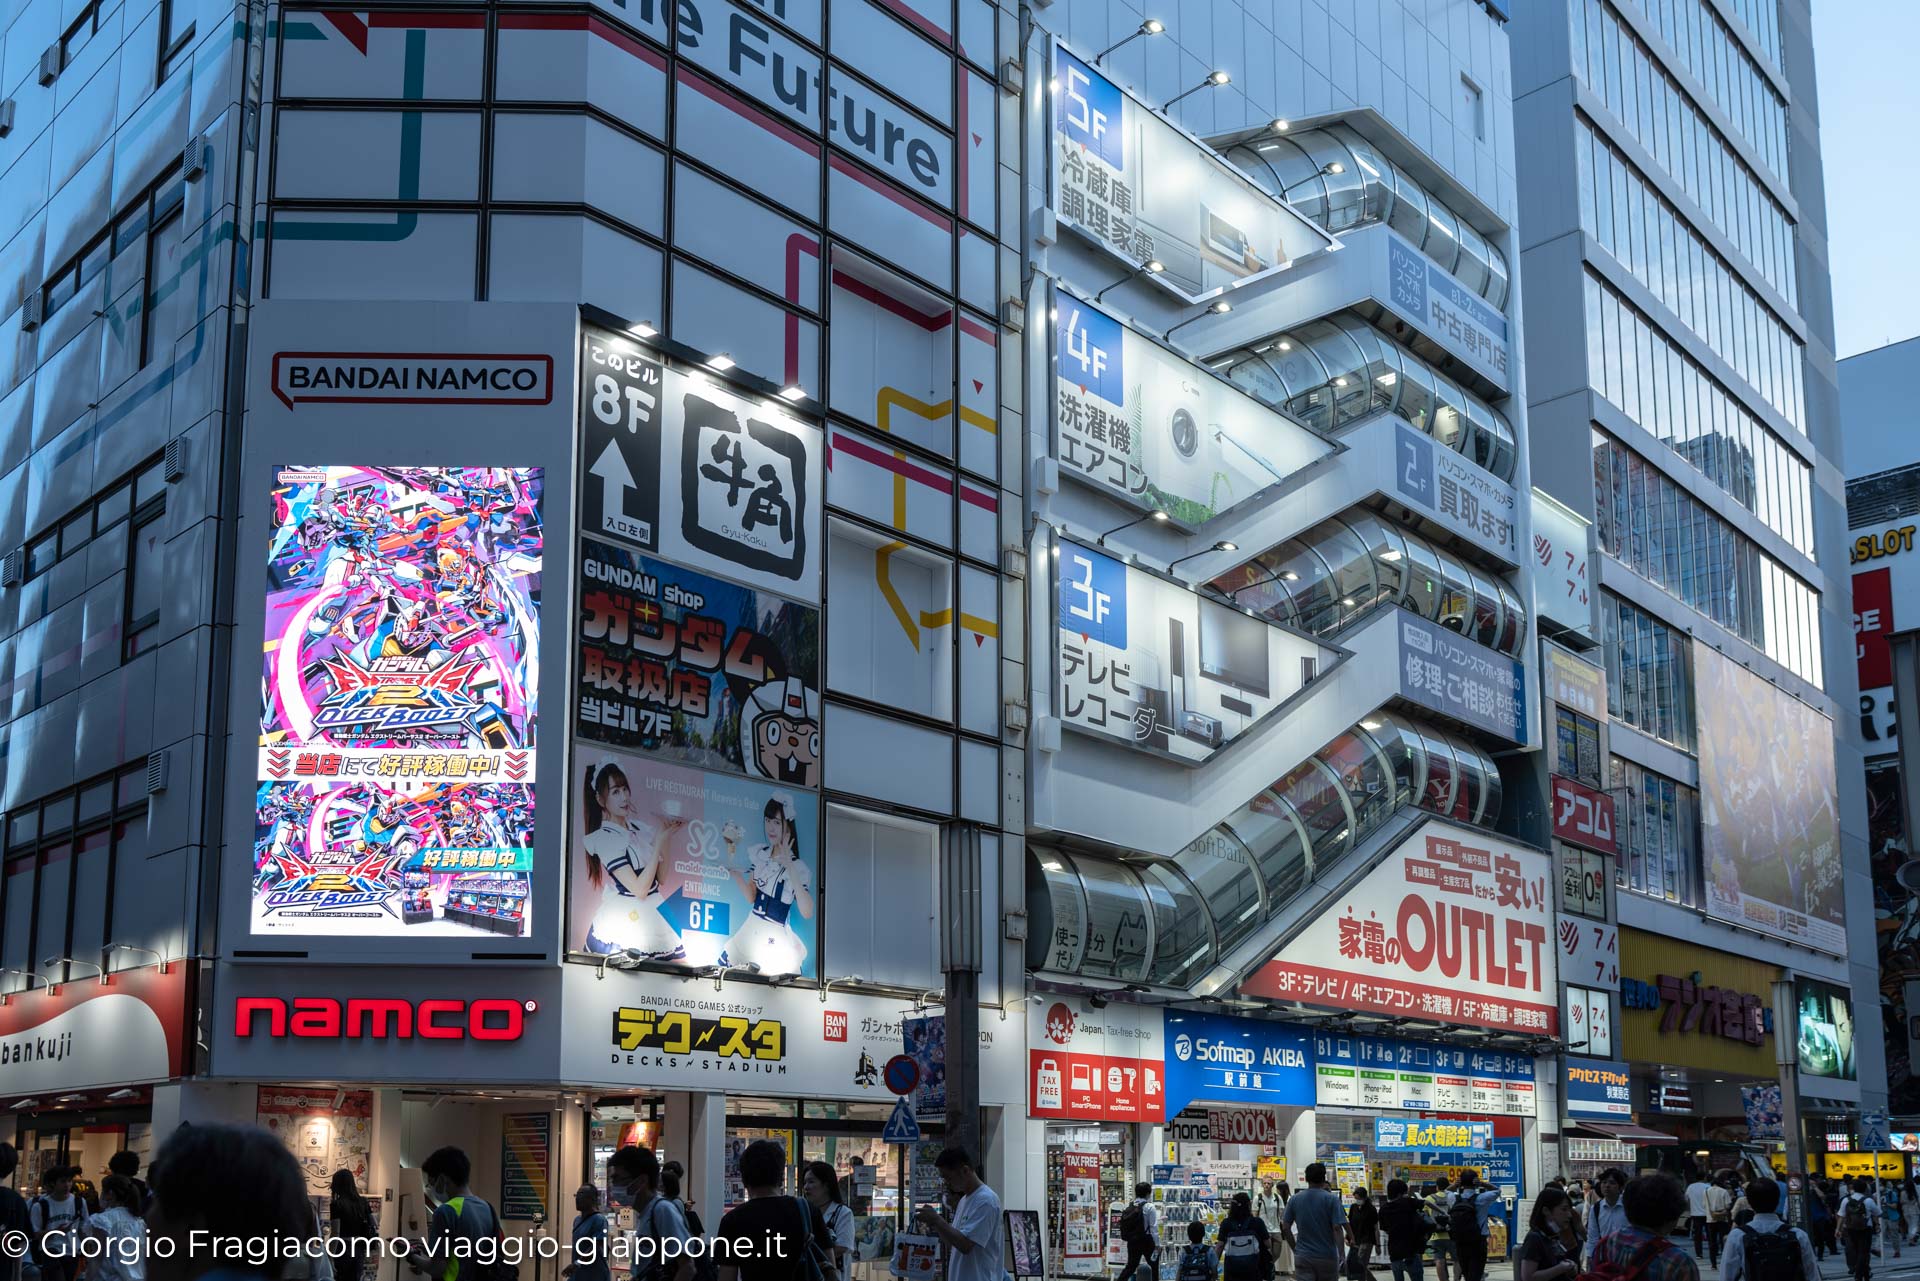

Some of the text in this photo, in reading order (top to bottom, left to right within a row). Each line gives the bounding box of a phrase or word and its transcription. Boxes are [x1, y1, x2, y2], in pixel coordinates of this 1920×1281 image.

[728, 12, 940, 188] Future
[1067, 64, 1108, 140] 5F
[1061, 144, 1133, 216] 冷蔵庫
[1062, 183, 1155, 265] 調理家電
[1392, 248, 1423, 279] パソコン
[1397, 270, 1421, 296] スマホ
[1398, 286, 1421, 311] カメラ
[1066, 309, 1108, 378] 4F
[1431, 300, 1506, 375] 中古専門店
[289, 365, 538, 391] BANDAI NAMCO
[591, 345, 659, 385] このビル
[592, 374, 656, 434] 8F
[1059, 389, 1131, 455] 洗濯機
[1060, 432, 1148, 494] エアコン
[1405, 441, 1427, 493] 2F
[700, 433, 794, 544] 牛角
[606, 516, 649, 541] 入口左側
[721, 525, 768, 548] Gyu-Kaku
[583, 558, 704, 611] GUNDAM shop
[1069, 554, 1111, 624] 3F
[582, 590, 765, 683] ガンダム
[369, 656, 431, 673] ガンダム
[1062, 643, 1131, 697] テレビ
[582, 647, 710, 716] 取扱店
[1405, 652, 1496, 719] 修理・ご相談
[368, 685, 430, 707] 2
[580, 696, 672, 737] 当ビル7F
[1064, 684, 1177, 741] レコーダー
[294, 753, 500, 777] 当店にて好評稼働中!
[646, 777, 662, 792] LIVE
[663, 779, 709, 801] RESTAURANT
[1556, 785, 1612, 841] アコム
[423, 848, 516, 868] 好評稼働中
[676, 861, 730, 881] maidreamin
[684, 880, 721, 897] ENTRANCE
[689, 901, 715, 931] 6F
[1396, 892, 1547, 993] OUTLET
[1278, 970, 1338, 1000] 3F:テレビ
[640, 995, 764, 1015] BANDAI CARD GAMES 公式ショップ
[234, 996, 524, 1041] namco
[1080, 1022, 1152, 1040] Japan. Tax-free Shop
[1, 1031, 72, 1066] bankuji
[1195, 1038, 1306, 1070] Sofmap AKIBA
[1318, 1037, 1331, 1057] B1
[1360, 1041, 1373, 1060] 1F
[1399, 1046, 1412, 1064] 2F
[1436, 1049, 1449, 1067] 3F
[611, 1053, 787, 1075] DECKS STADIUM
[1471, 1053, 1484, 1071] 4F
[1504, 1057, 1516, 1073] 5F
[1040, 1087, 1058, 1096] FREE
[1042, 1075, 1057, 1085] TAX
[1224, 1071, 1263, 1089] 駅前館
[1325, 1080, 1349, 1090] Windows
[1411, 1087, 1422, 1095] Mac
[1437, 1088, 1451, 1098] テレビ
[1115, 1097, 1130, 1105] Home
[1364, 1095, 1379, 1104] カメラ
[1437, 1099, 1460, 1109] レコーダー
[1472, 1101, 1490, 1111] エアコン
[1405, 1122, 1473, 1148] 夏の大商談会!
[1066, 1154, 1099, 1168] TAX FREE
